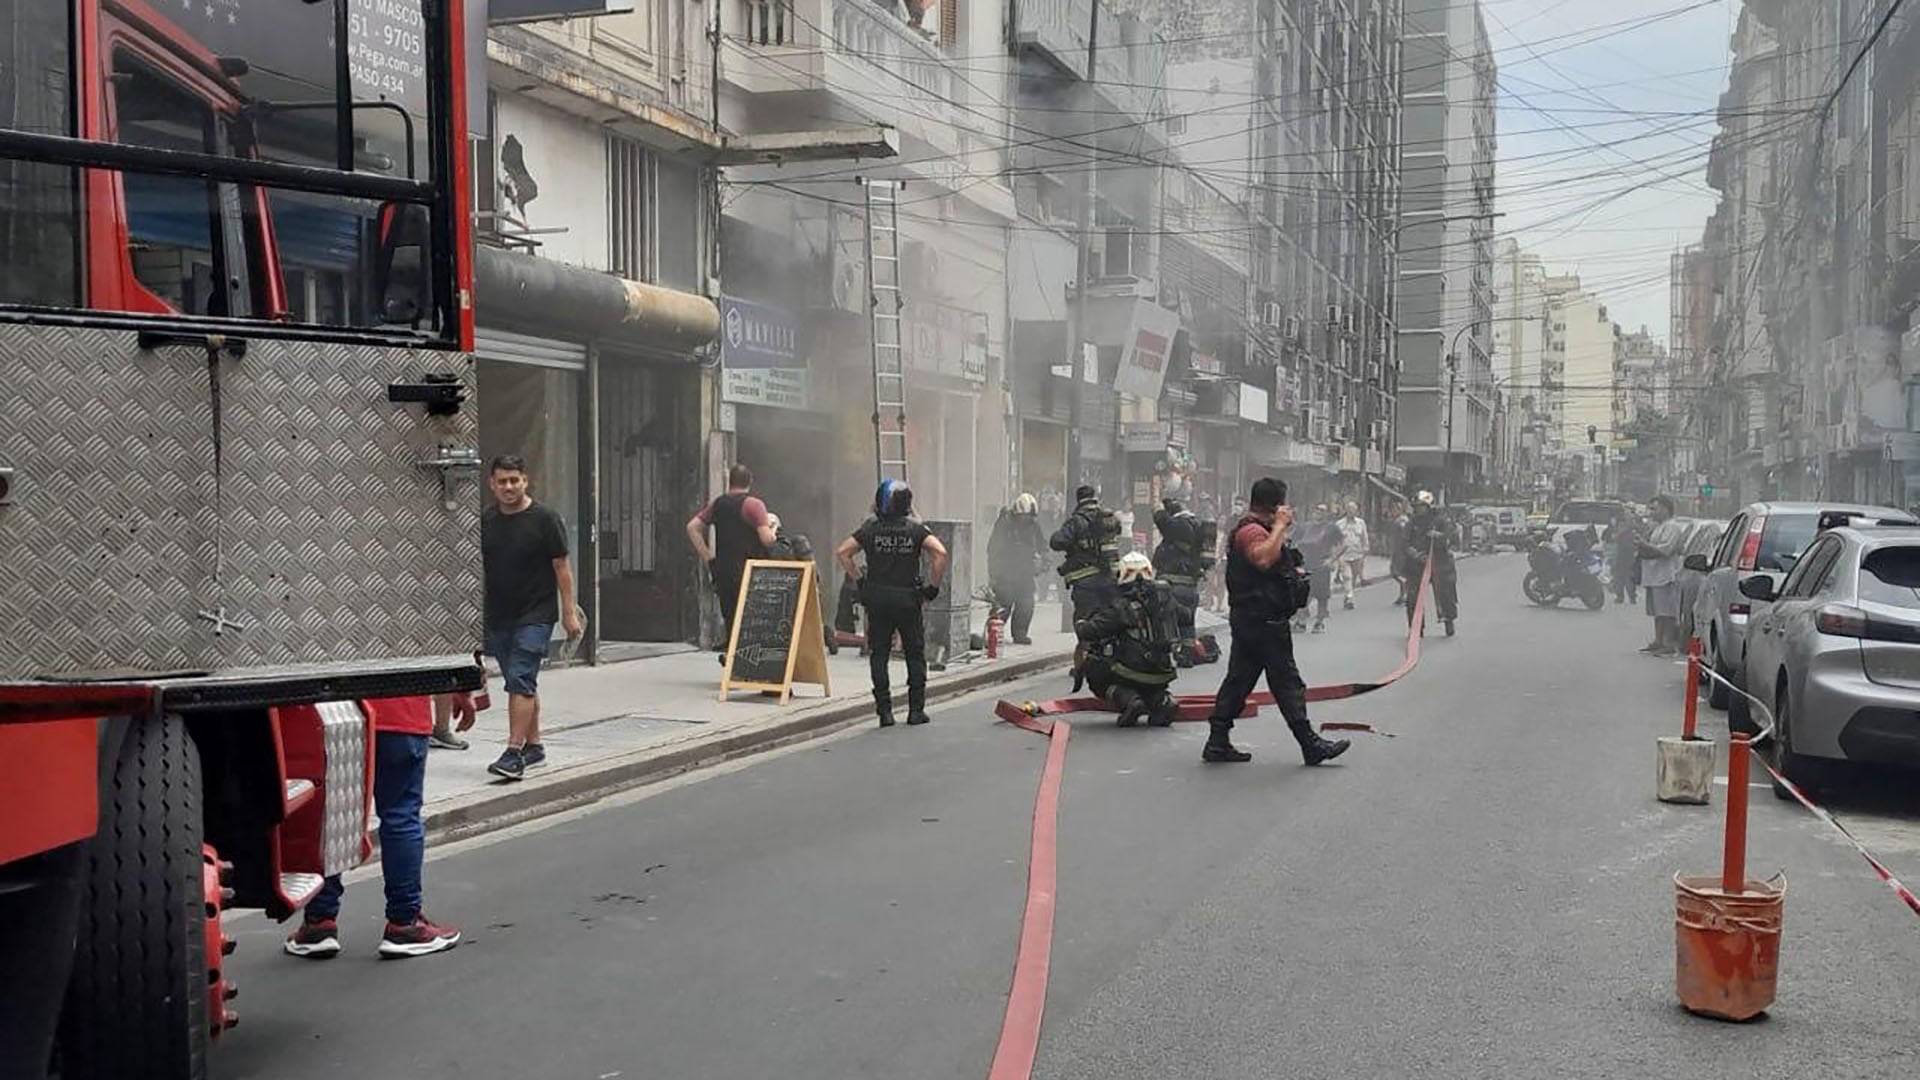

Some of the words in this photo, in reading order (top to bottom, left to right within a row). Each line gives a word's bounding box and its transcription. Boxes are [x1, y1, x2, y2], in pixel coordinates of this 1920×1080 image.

[384, 25, 420, 54] 9705
[350, 63, 380, 87] PASO
[382, 74, 404, 94] 434
